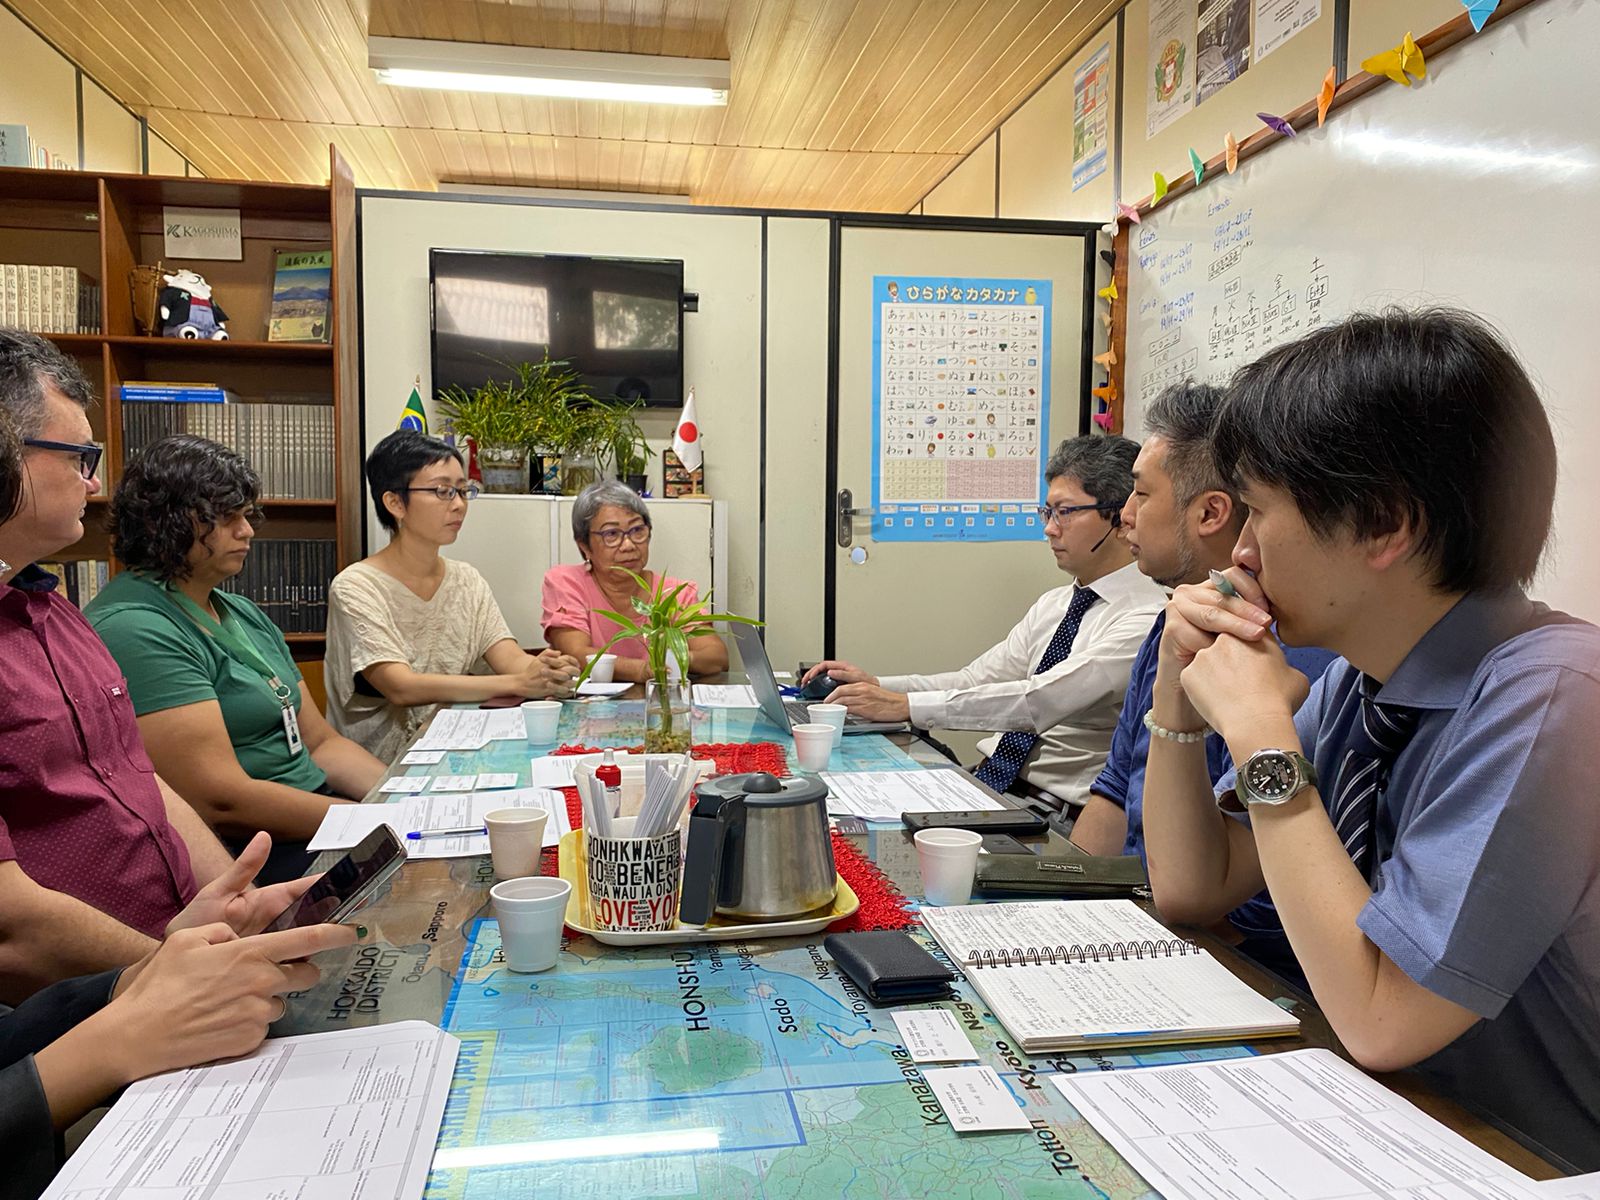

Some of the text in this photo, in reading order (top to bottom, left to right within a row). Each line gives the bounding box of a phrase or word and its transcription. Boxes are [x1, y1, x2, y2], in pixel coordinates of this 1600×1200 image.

[906, 285, 1019, 302] ひらがなカタカナ
[617, 860, 665, 886] BENE
[613, 886, 637, 900] WAU
[642, 884, 653, 899] IA
[648, 889, 679, 924] YOU
[422, 901, 448, 940] Sapporo
[806, 944, 832, 980] Nagano
[326, 947, 380, 1020] HOKKAIDŌ
[671, 952, 710, 1031] HONSHŪ
[839, 976, 868, 1017] Toyama
[769, 998, 798, 1033] Sado
[996, 1041, 1042, 1090] Kyōto
[891, 1049, 948, 1126] Kanazawa
